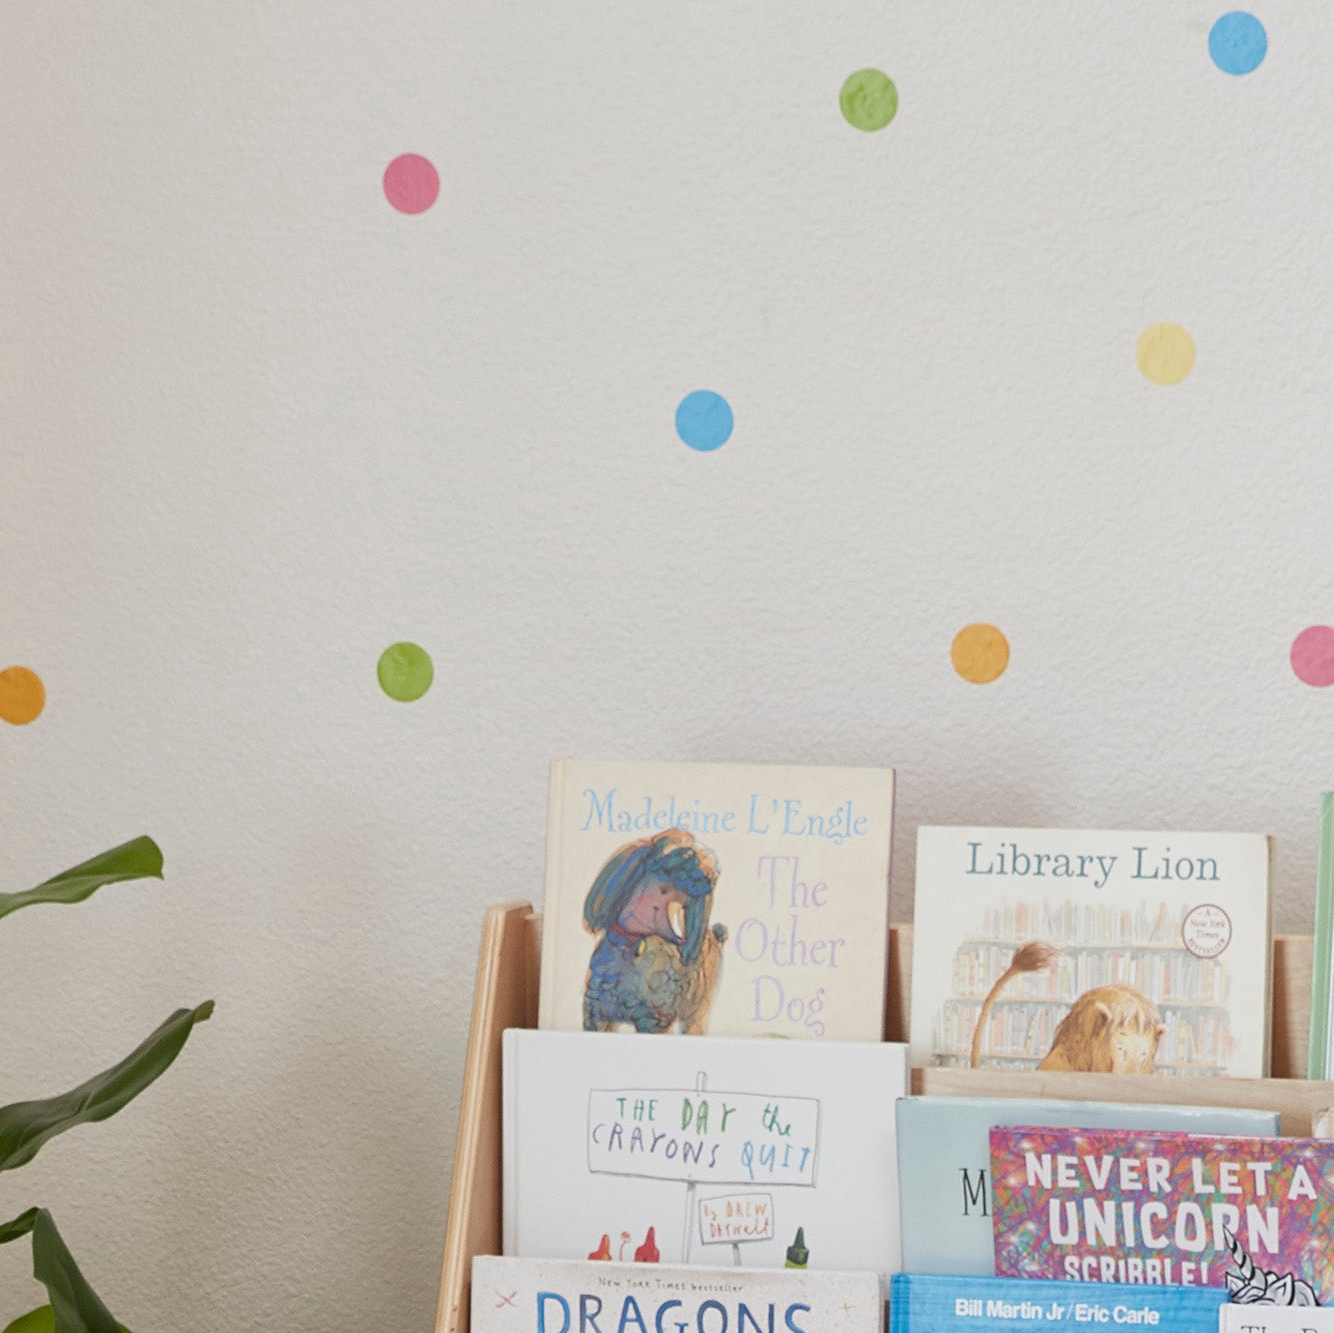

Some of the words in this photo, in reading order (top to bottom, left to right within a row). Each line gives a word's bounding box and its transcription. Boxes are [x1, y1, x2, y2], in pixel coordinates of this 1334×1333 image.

[580, 788, 736, 834] Madeleine
[747, 794, 868, 845] L'Engle
[756, 855, 829, 909] The
[965, 841, 1118, 889] Library
[1130, 846, 1220, 882] Lion
[734, 914, 846, 969] Other
[750, 974, 827, 1037] Dog
[616, 1097, 659, 1122] THE
[681, 1097, 737, 1136] DAY
[762, 1103, 791, 1137] the
[592, 1122, 720, 1169] CRAYONS
[740, 1140, 811, 1181] QUIT
[1024, 1151, 1171, 1194] NEVER
[1191, 1157, 1273, 1197] LET
[1286, 1166, 1318, 1201] A
[1047, 1197, 1280, 1255] UNICORN
[954, 1298, 983, 1317] Bill
[986, 1300, 1042, 1319] Martin
[1112, 1305, 1160, 1325] Carle
